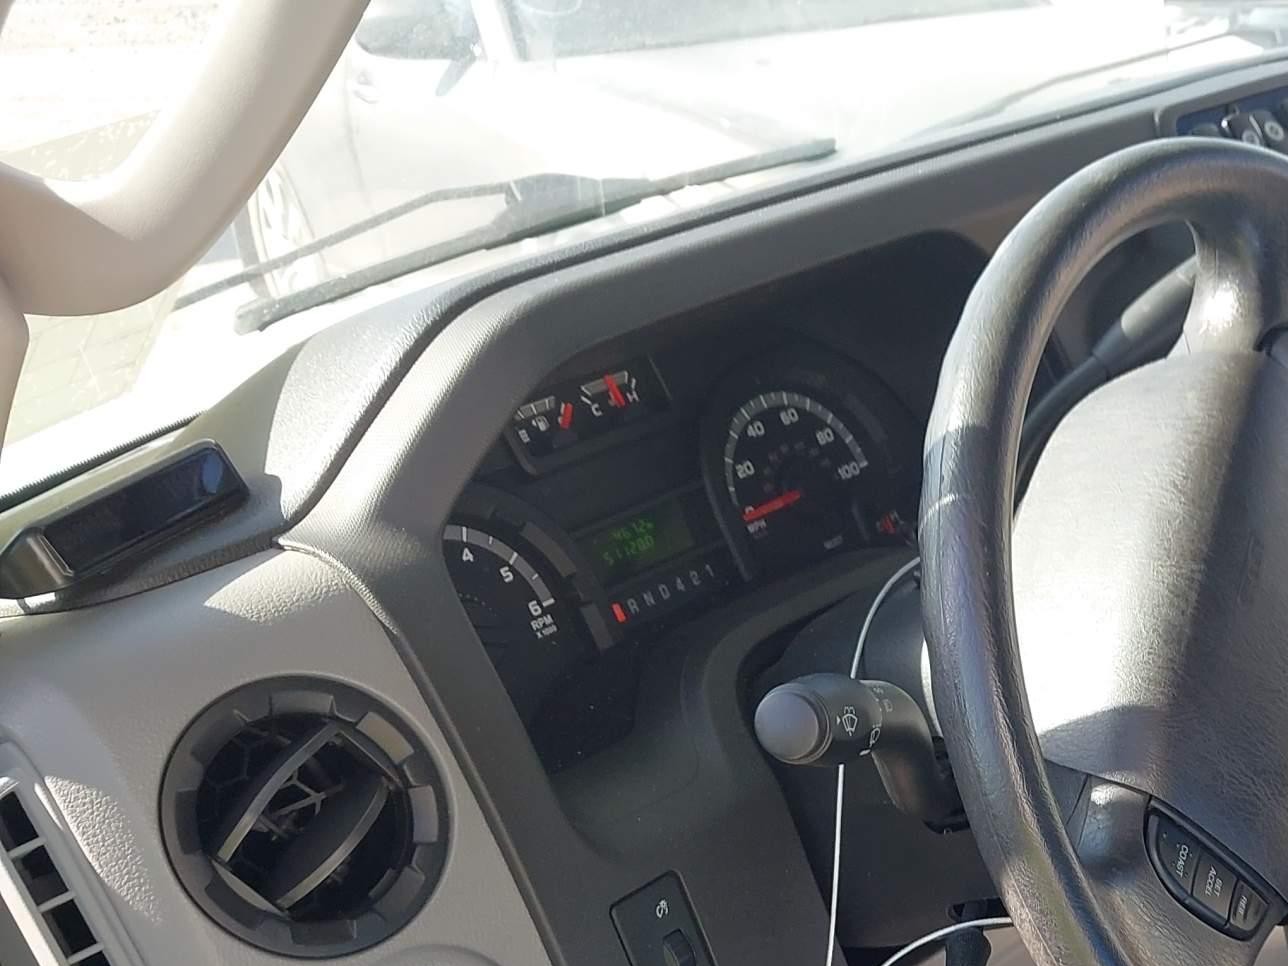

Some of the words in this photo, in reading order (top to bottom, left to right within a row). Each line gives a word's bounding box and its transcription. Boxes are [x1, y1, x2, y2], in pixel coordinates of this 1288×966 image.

[779, 407, 799, 426] 60
[747, 420, 765, 438] 40
[815, 427, 834, 446] 80
[736, 460, 755, 479] 20
[838, 461, 861, 480] 100
[462, 547, 474, 562] 4
[500, 566, 514, 583] 5
[643, 591, 656, 607] N
[658, 584, 670, 600] D
[528, 600, 542, 616] 6
[530, 614, 554, 631] RPM
[1176, 844, 1189, 878] COAST
[1205, 865, 1217, 897] ACCEL
[1213, 878, 1223, 897] SET
